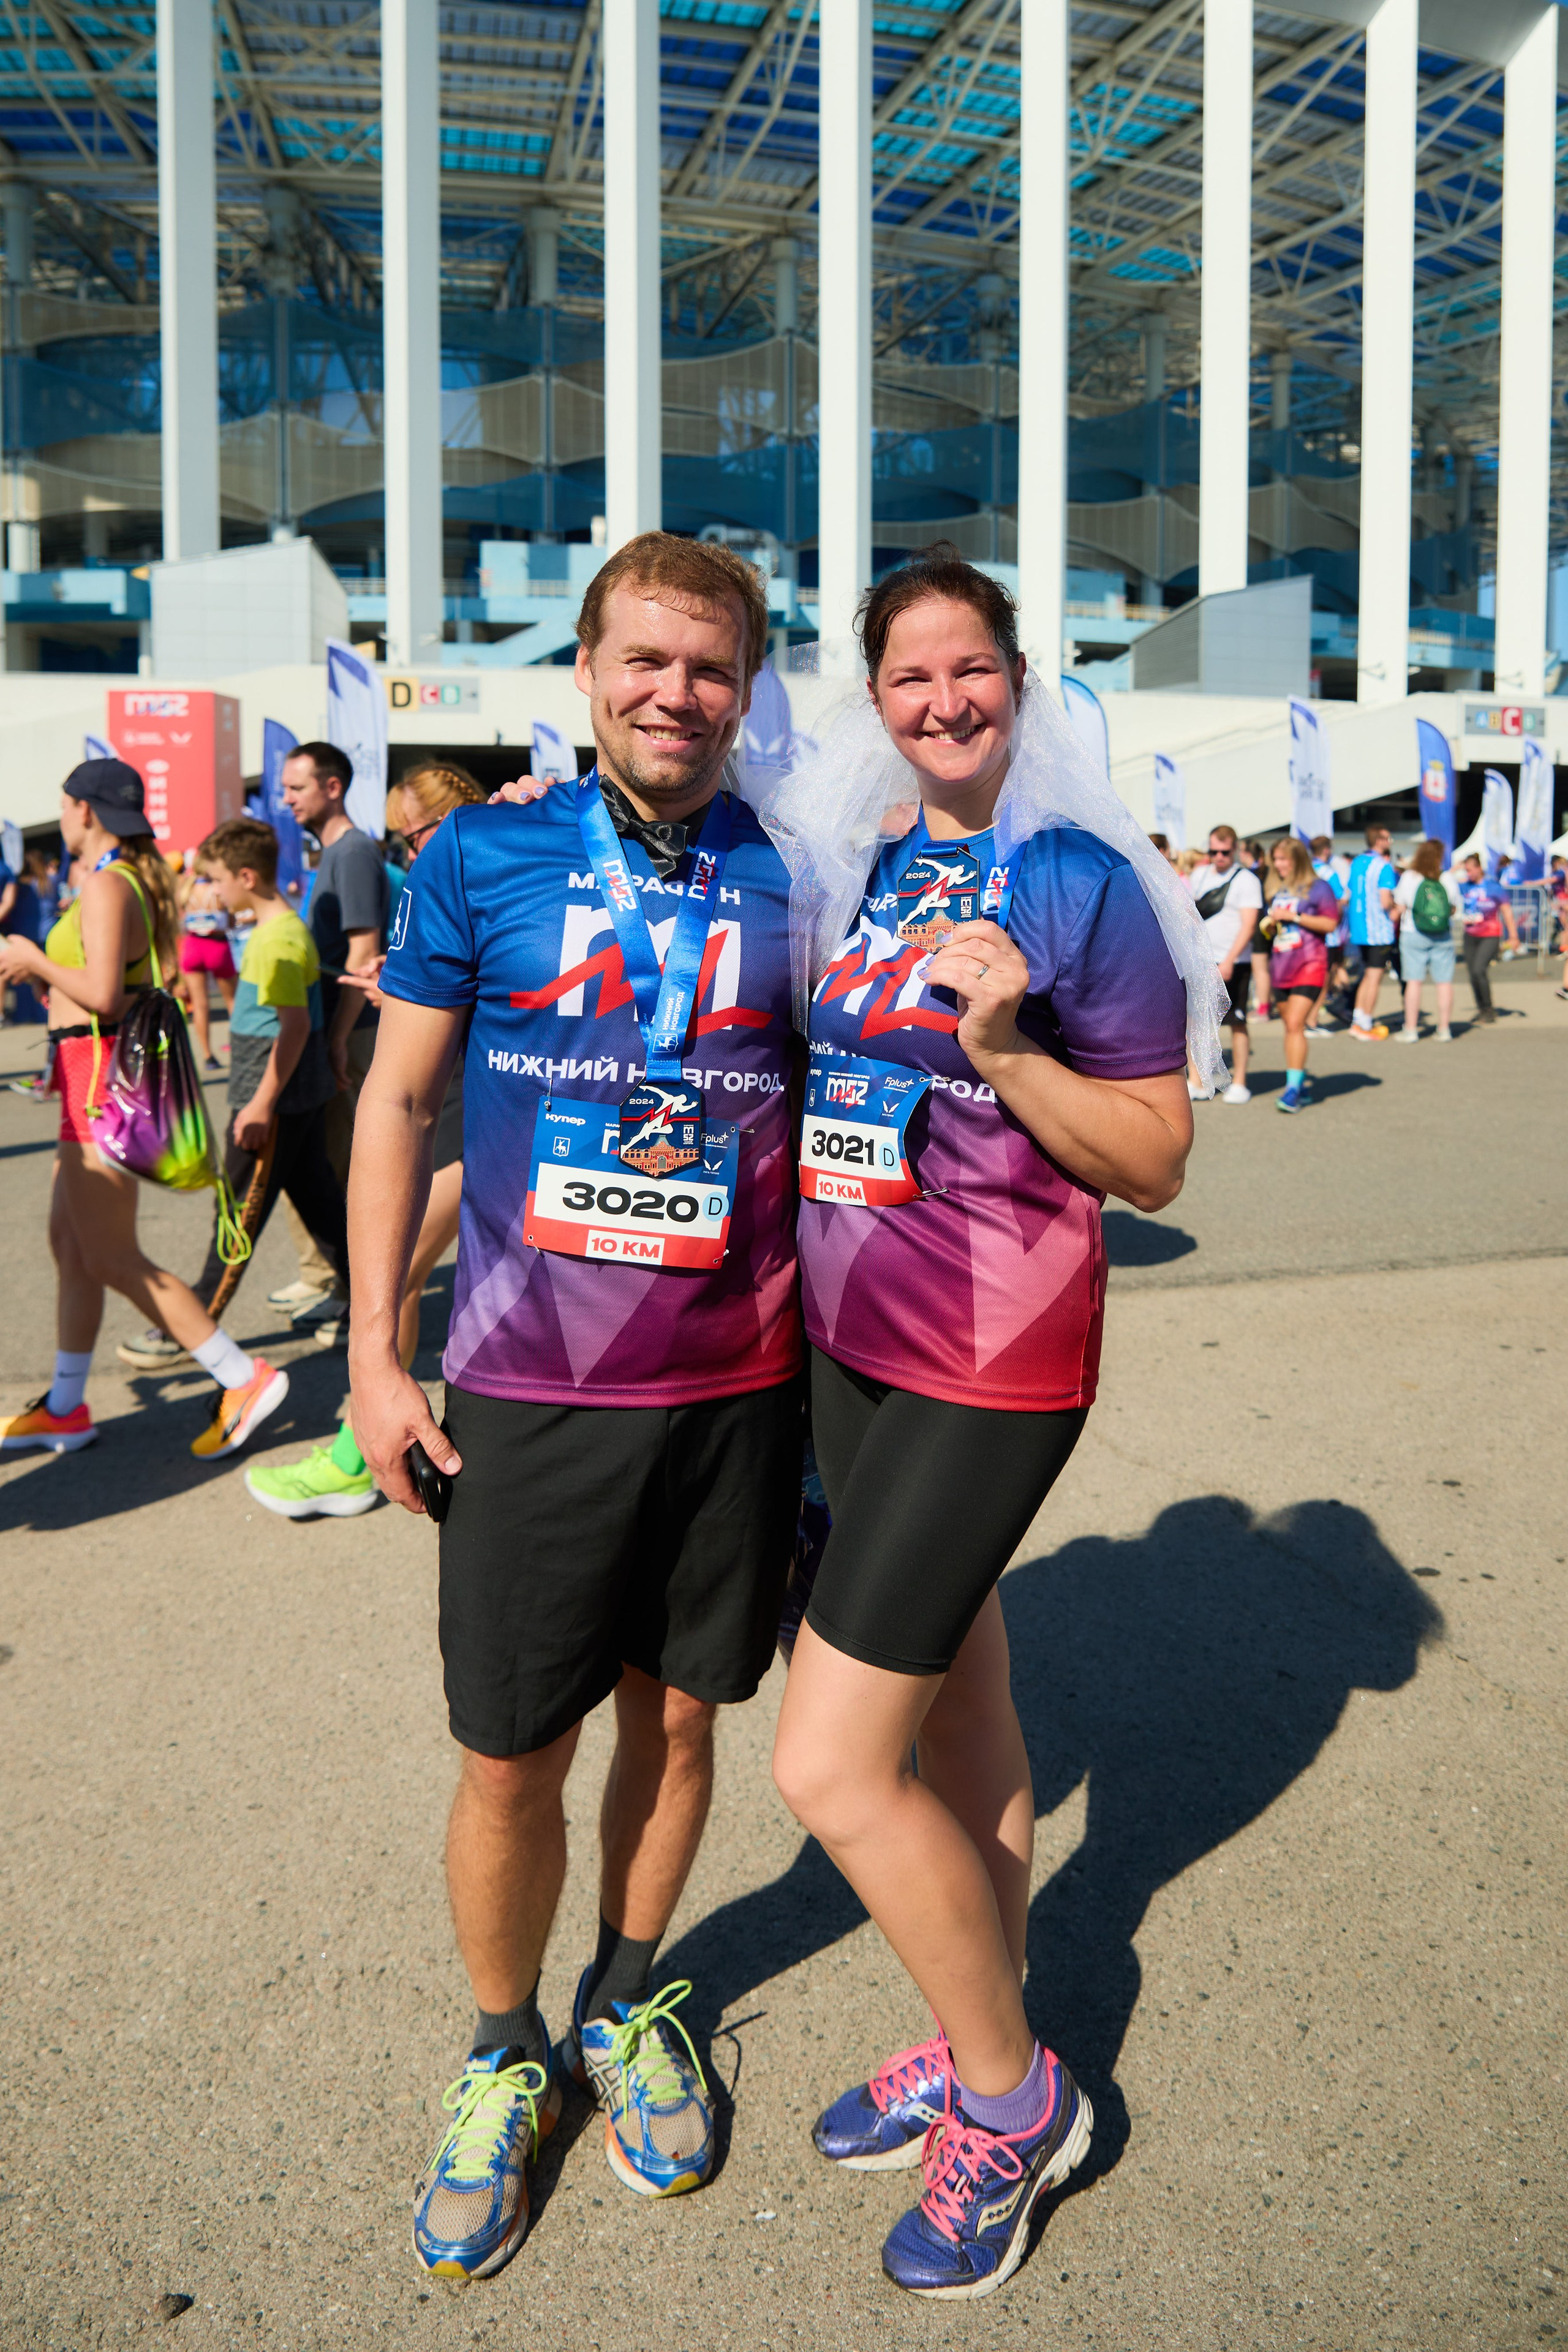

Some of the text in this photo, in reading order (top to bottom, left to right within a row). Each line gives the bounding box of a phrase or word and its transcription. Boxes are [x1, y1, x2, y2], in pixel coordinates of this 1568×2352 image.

[392, 682, 412, 708] D
[1503, 707, 1520, 735] C
[905, 871, 931, 880] 2024
[662, 997, 674, 1030] НИЖНИЙ
[670, 992, 685, 1030] НОВГОРОД
[488, 1049, 785, 1094] НИЖНИЙ НВГОРОД
[812, 1129, 894, 1166] 3021 D
[562, 1182, 722, 1223] 3020 D
[818, 1181, 833, 1195] 10
[592, 1237, 617, 1253] 10
